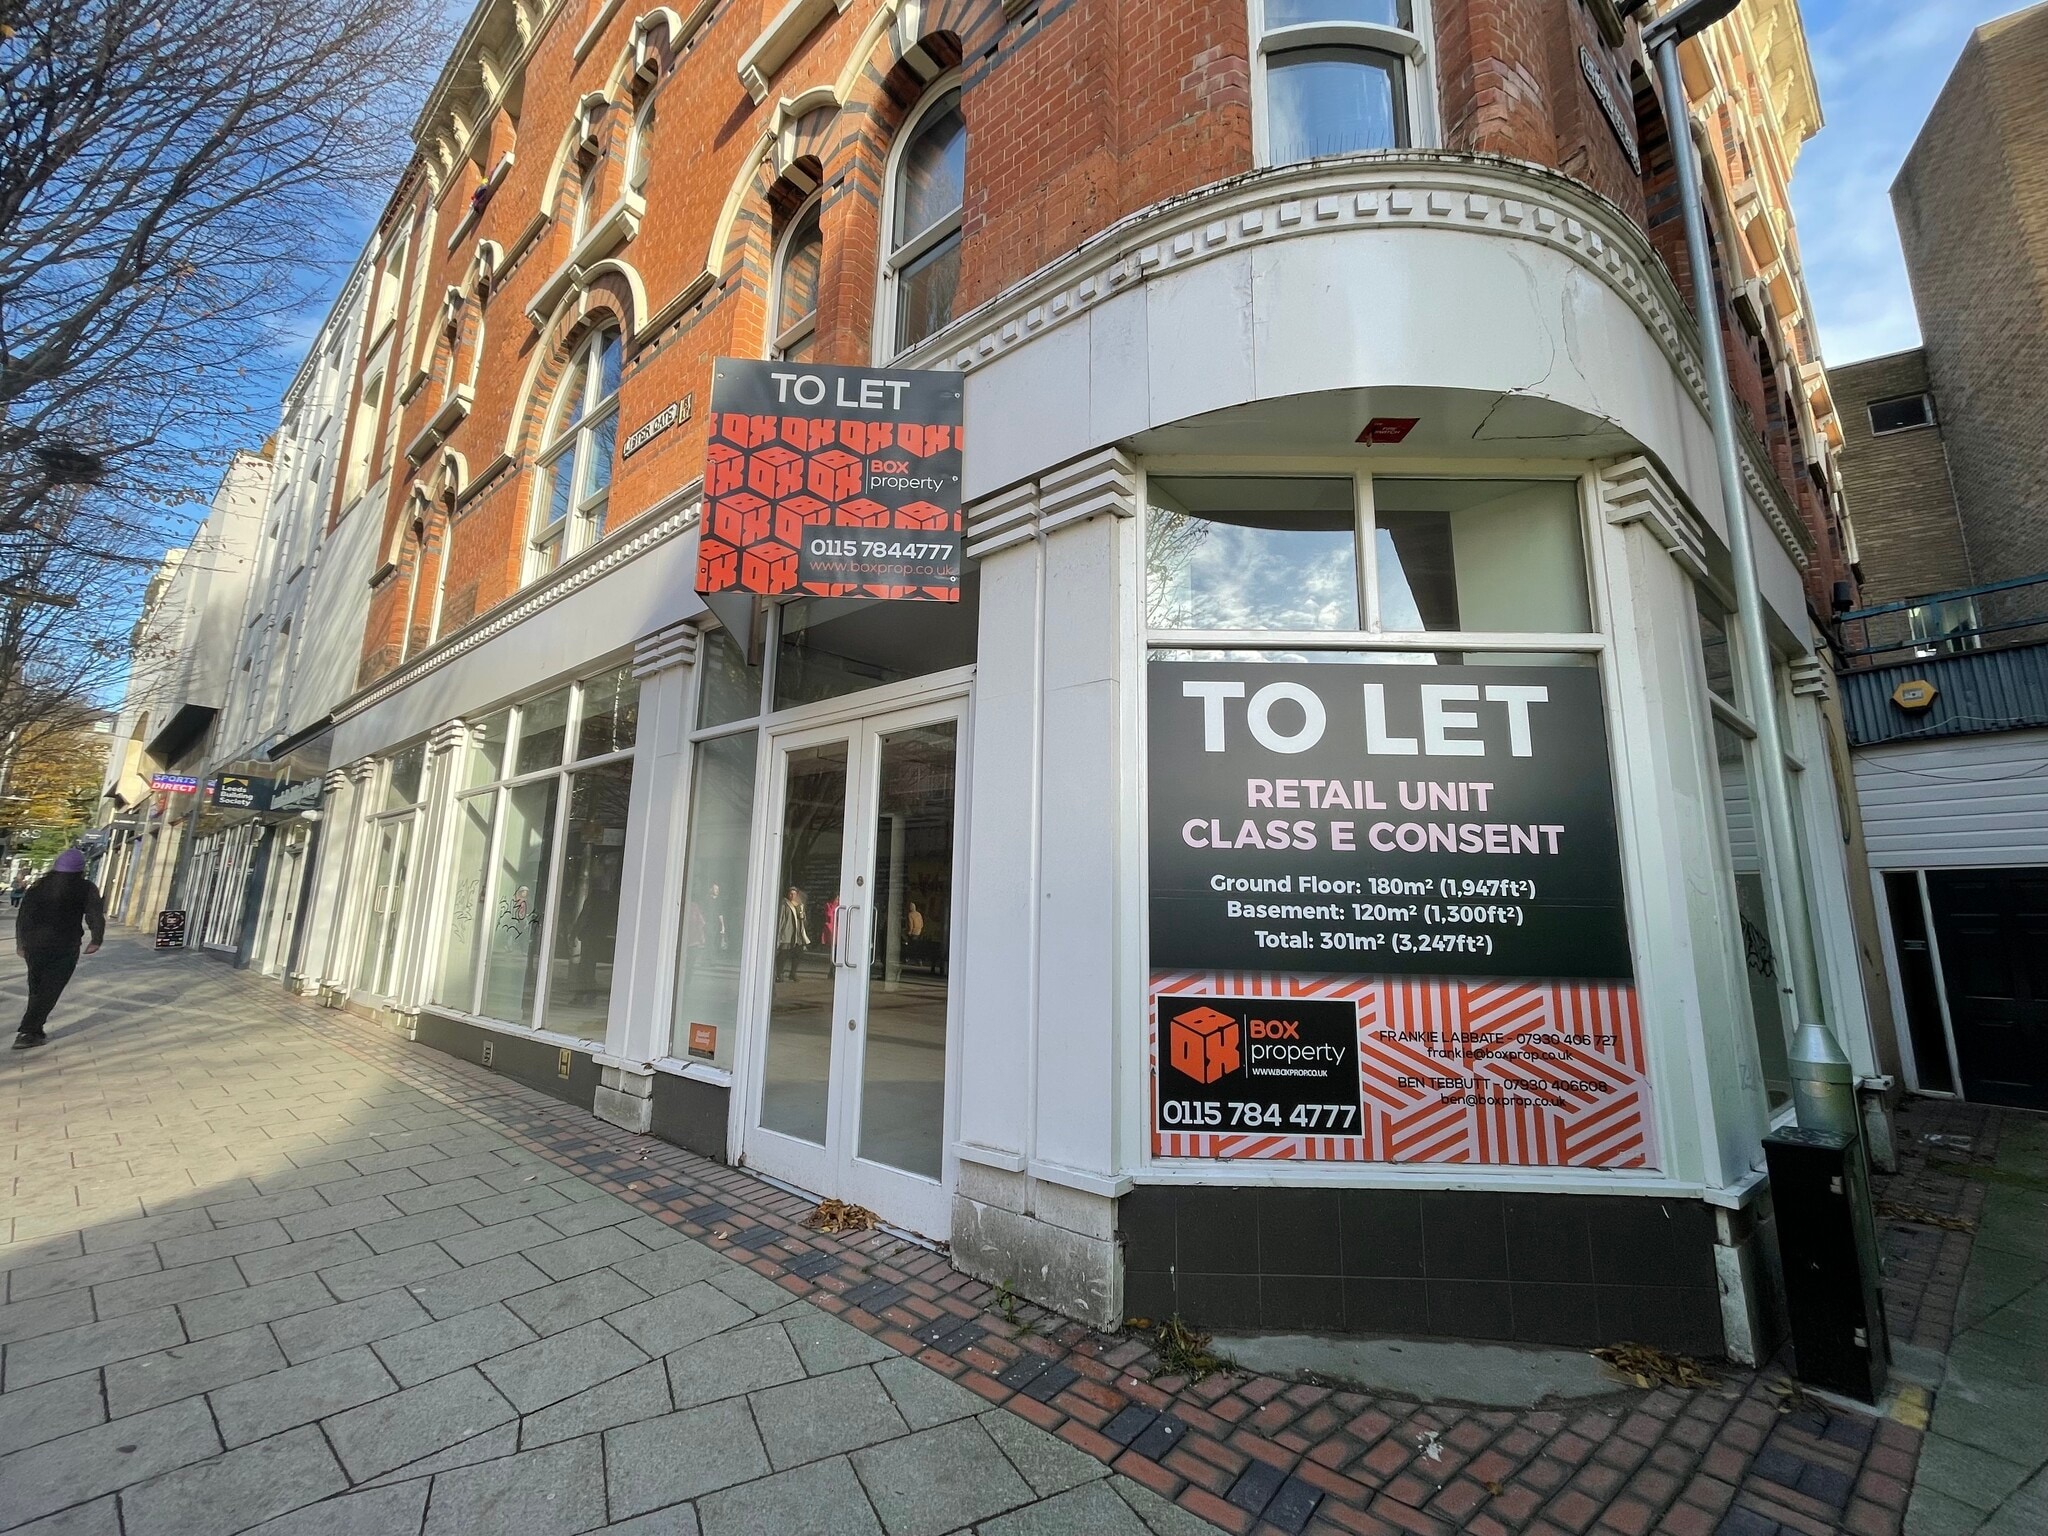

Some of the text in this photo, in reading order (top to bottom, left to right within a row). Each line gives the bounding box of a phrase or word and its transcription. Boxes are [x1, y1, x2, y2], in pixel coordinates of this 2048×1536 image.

[771, 373, 911, 410] TO LET
[870, 460, 909, 474] BOX
[871, 475, 944, 493] property
[810, 539, 953, 560] 0115 7844777
[1182, 681, 1549, 757] TO LET
[152, 783, 195, 792] DIRECT
[154, 774, 197, 784] SPORTS
[220, 791, 253, 801] Building
[222, 785, 247, 793] Leeds
[1247, 778, 1494, 812] RETAIL UNIT
[219, 797, 251, 806] Society
[1181, 818, 1565, 855] CLASS E CONSENT
[1210, 874, 1537, 900] Ground Floor: 180m² (1,947ft²)
[1227, 901, 1524, 926] Basement: 120m² (1,300ft²)
[1254, 930, 1493, 955] Total: 301m² (3,247ft²)
[1249, 1019, 1300, 1040] BOX
[1379, 1030, 1438, 1043] FRANKIE
[1442, 1031, 1504, 1044] LABBATE
[1516, 1033, 1560, 1045] 07930
[1563, 1034, 1591, 1045] 406
[1593, 1034, 1618, 1046] 727
[1251, 1042, 1346, 1065] property
[1427, 1046, 1573, 1062] frankie@boxprop.co.uk
[1398, 1076, 1425, 1089] BEN
[1429, 1077, 1491, 1090] TEBBUTT
[1503, 1078, 1547, 1091] 07930
[1551, 1079, 1608, 1092] 406608
[1440, 1093, 1566, 1108] ben@boxprop.co.uk
[1163, 1100, 1356, 1129] 0115 784 4777
